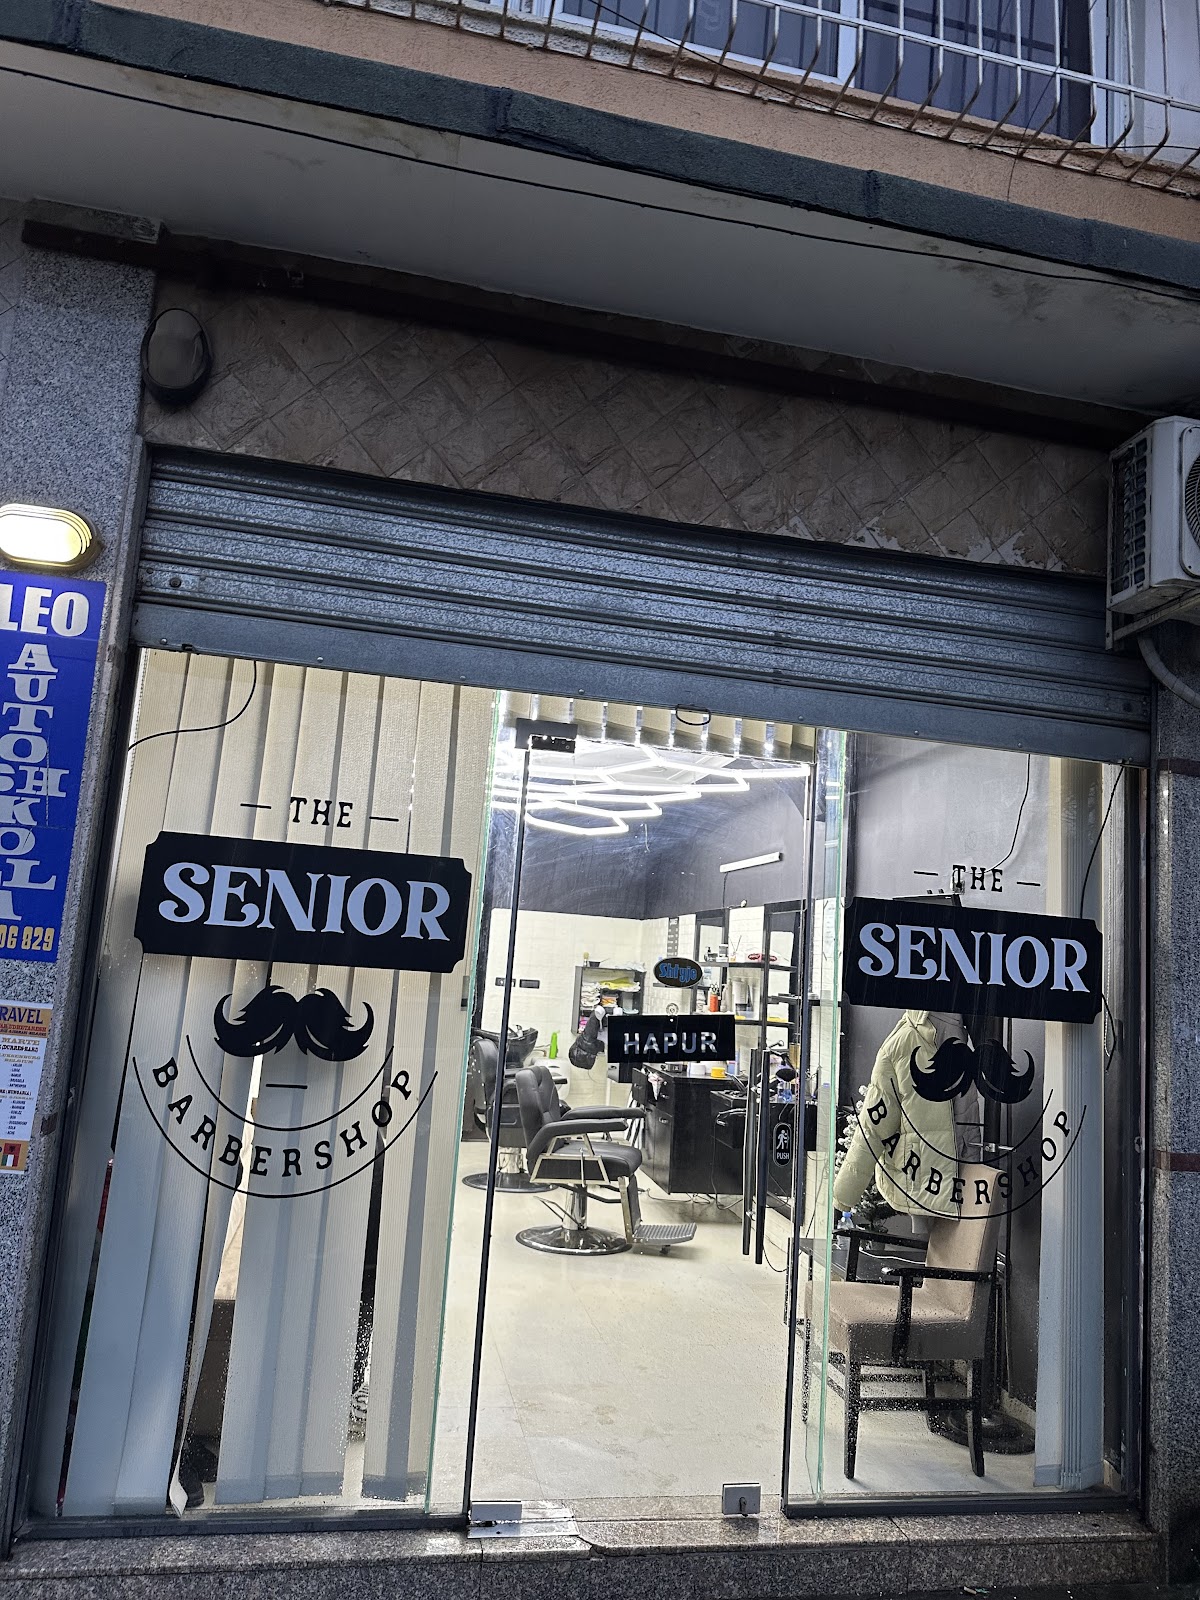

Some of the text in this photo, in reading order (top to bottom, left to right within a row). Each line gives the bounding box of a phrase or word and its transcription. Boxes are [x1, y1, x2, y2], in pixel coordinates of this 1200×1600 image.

[0, 583, 90, 637] LEO
[289, 796, 354, 828] THE
[952, 864, 1003, 893] THE
[158, 862, 451, 942] SENIOR
[21, 926, 55, 951] 829
[659, 963, 697, 983] Shtyje
[857, 922, 1091, 993] SENIOR
[623, 1031, 718, 1055] HAPUR
[152, 1056, 412, 1177] BARBERSHOP
[776, 1152, 790, 1160] PUSH
[867, 1097, 1071, 1206] BARBERSHOP
